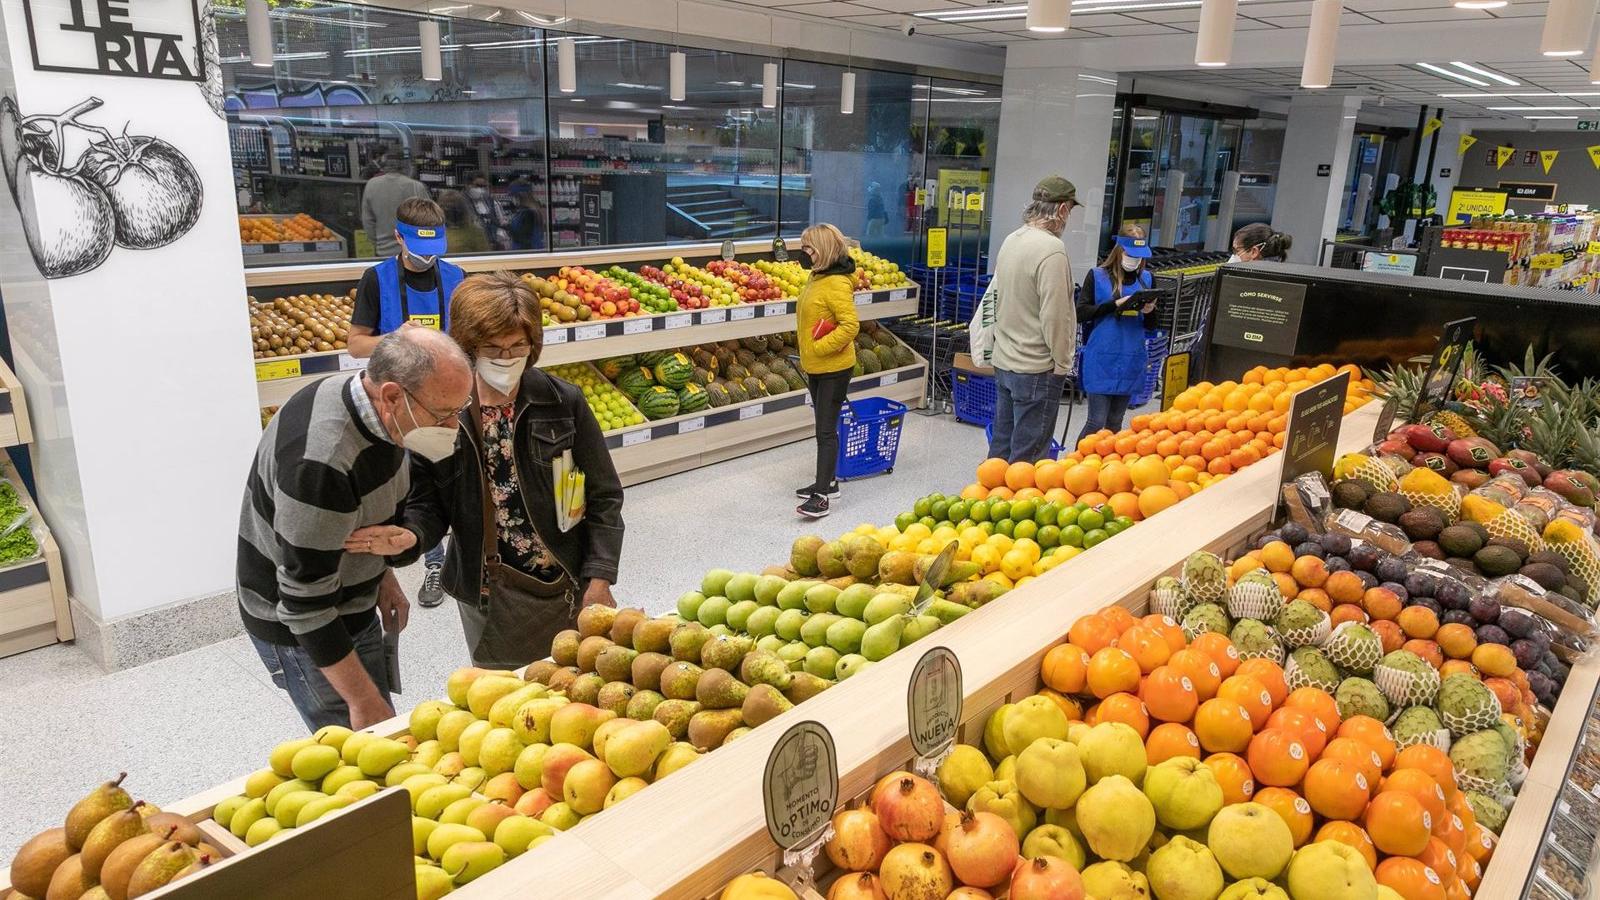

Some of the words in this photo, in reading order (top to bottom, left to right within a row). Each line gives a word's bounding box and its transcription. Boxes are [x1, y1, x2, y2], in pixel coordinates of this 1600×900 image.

[1466, 204, 1494, 213] UNIDAD
[1257, 292, 1283, 303] SERVIRSE
[920, 717, 955, 745] NUEVA
[786, 787, 819, 811] MOMENTO
[781, 799, 830, 837] ÓPTIMO
